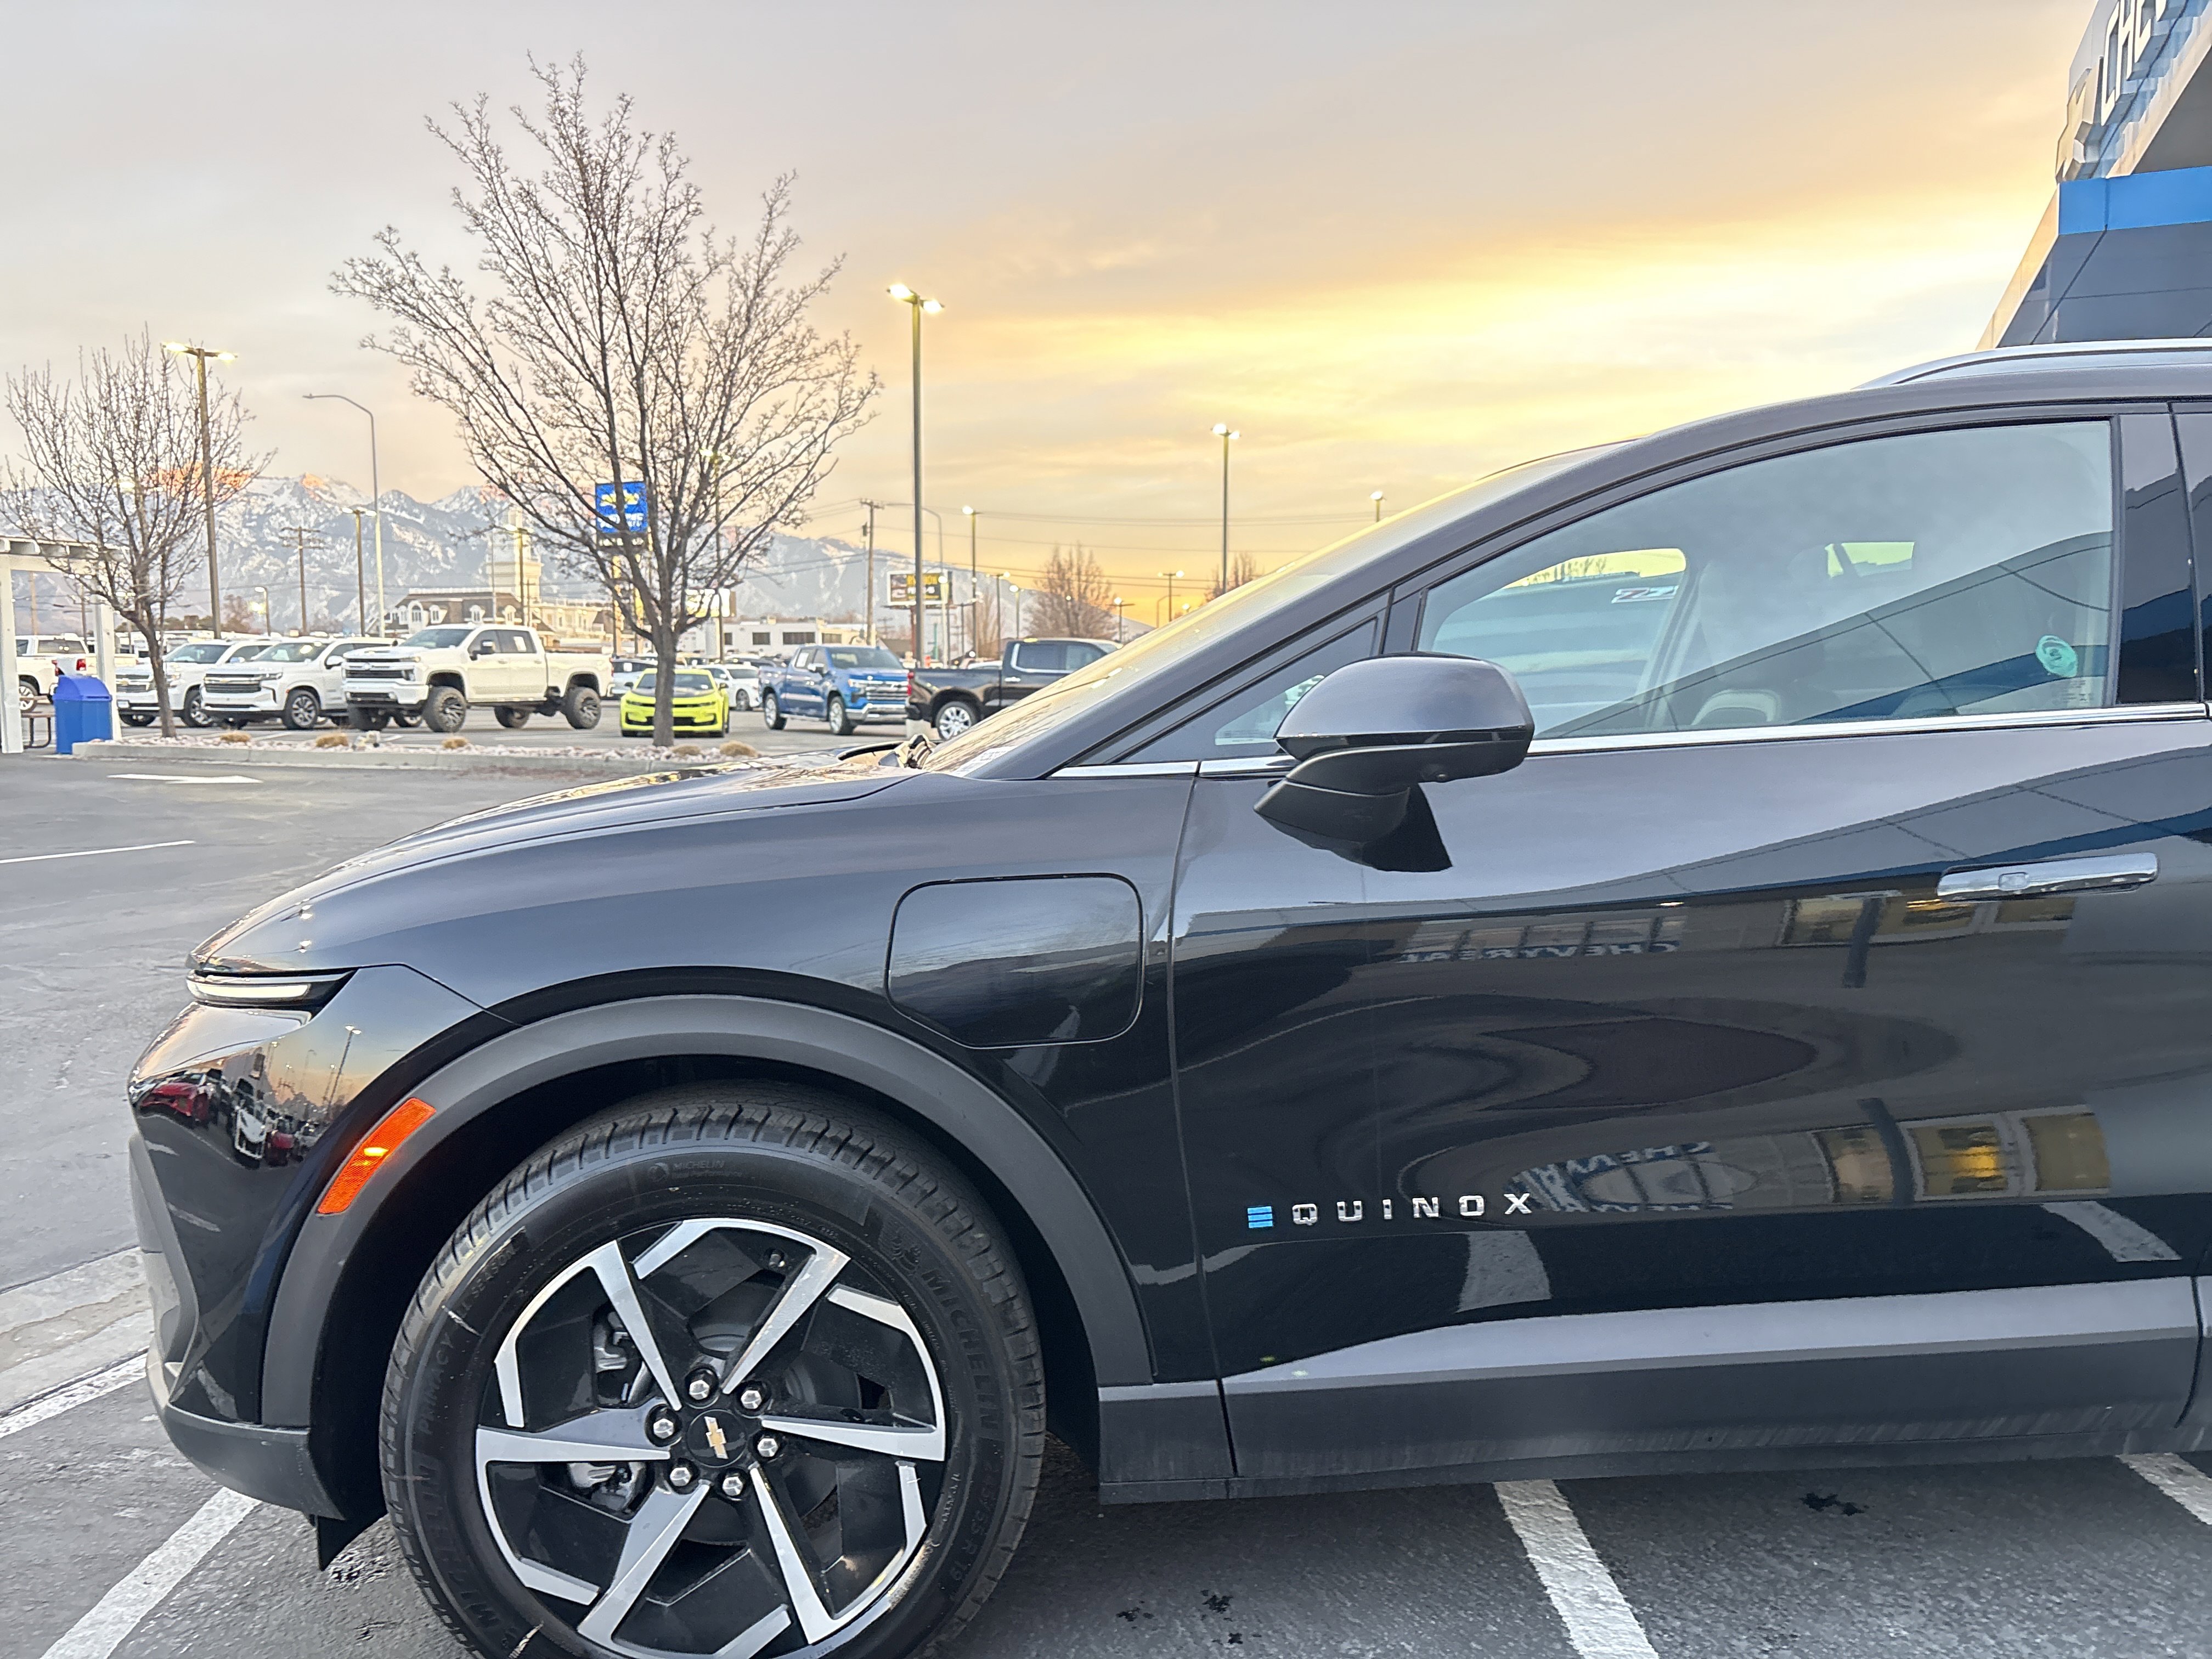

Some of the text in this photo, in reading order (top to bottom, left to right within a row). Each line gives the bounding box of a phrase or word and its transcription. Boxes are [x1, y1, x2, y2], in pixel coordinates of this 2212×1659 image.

[2101, 0, 2167, 126] CHE
[1247, 1192, 1532, 1229] EQUINOX
[921, 1268, 1000, 1430] MICHELIN
